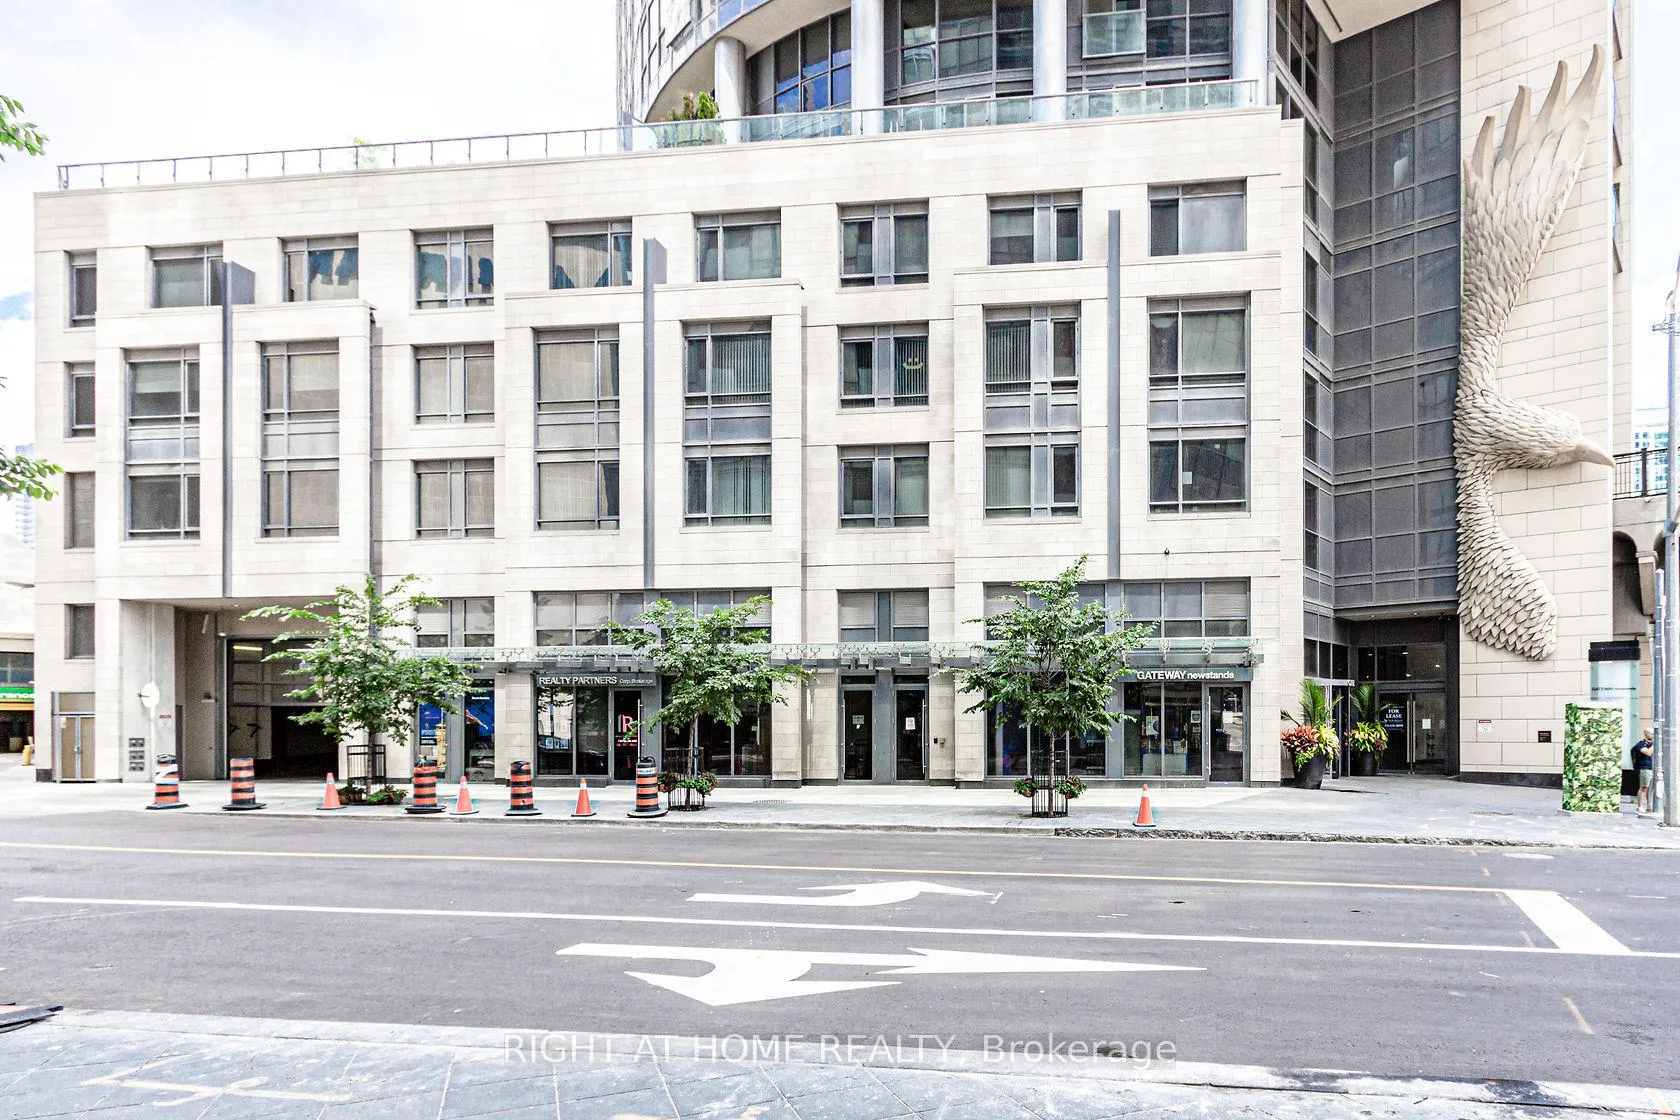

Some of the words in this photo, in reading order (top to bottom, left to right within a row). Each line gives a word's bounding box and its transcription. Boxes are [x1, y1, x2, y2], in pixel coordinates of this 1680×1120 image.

[1137, 670, 1185, 680] GATEWAY
[1187, 670, 1235, 680] newstands
[539, 676, 571, 685] REALTY
[572, 676, 618, 685] PARTNERS
